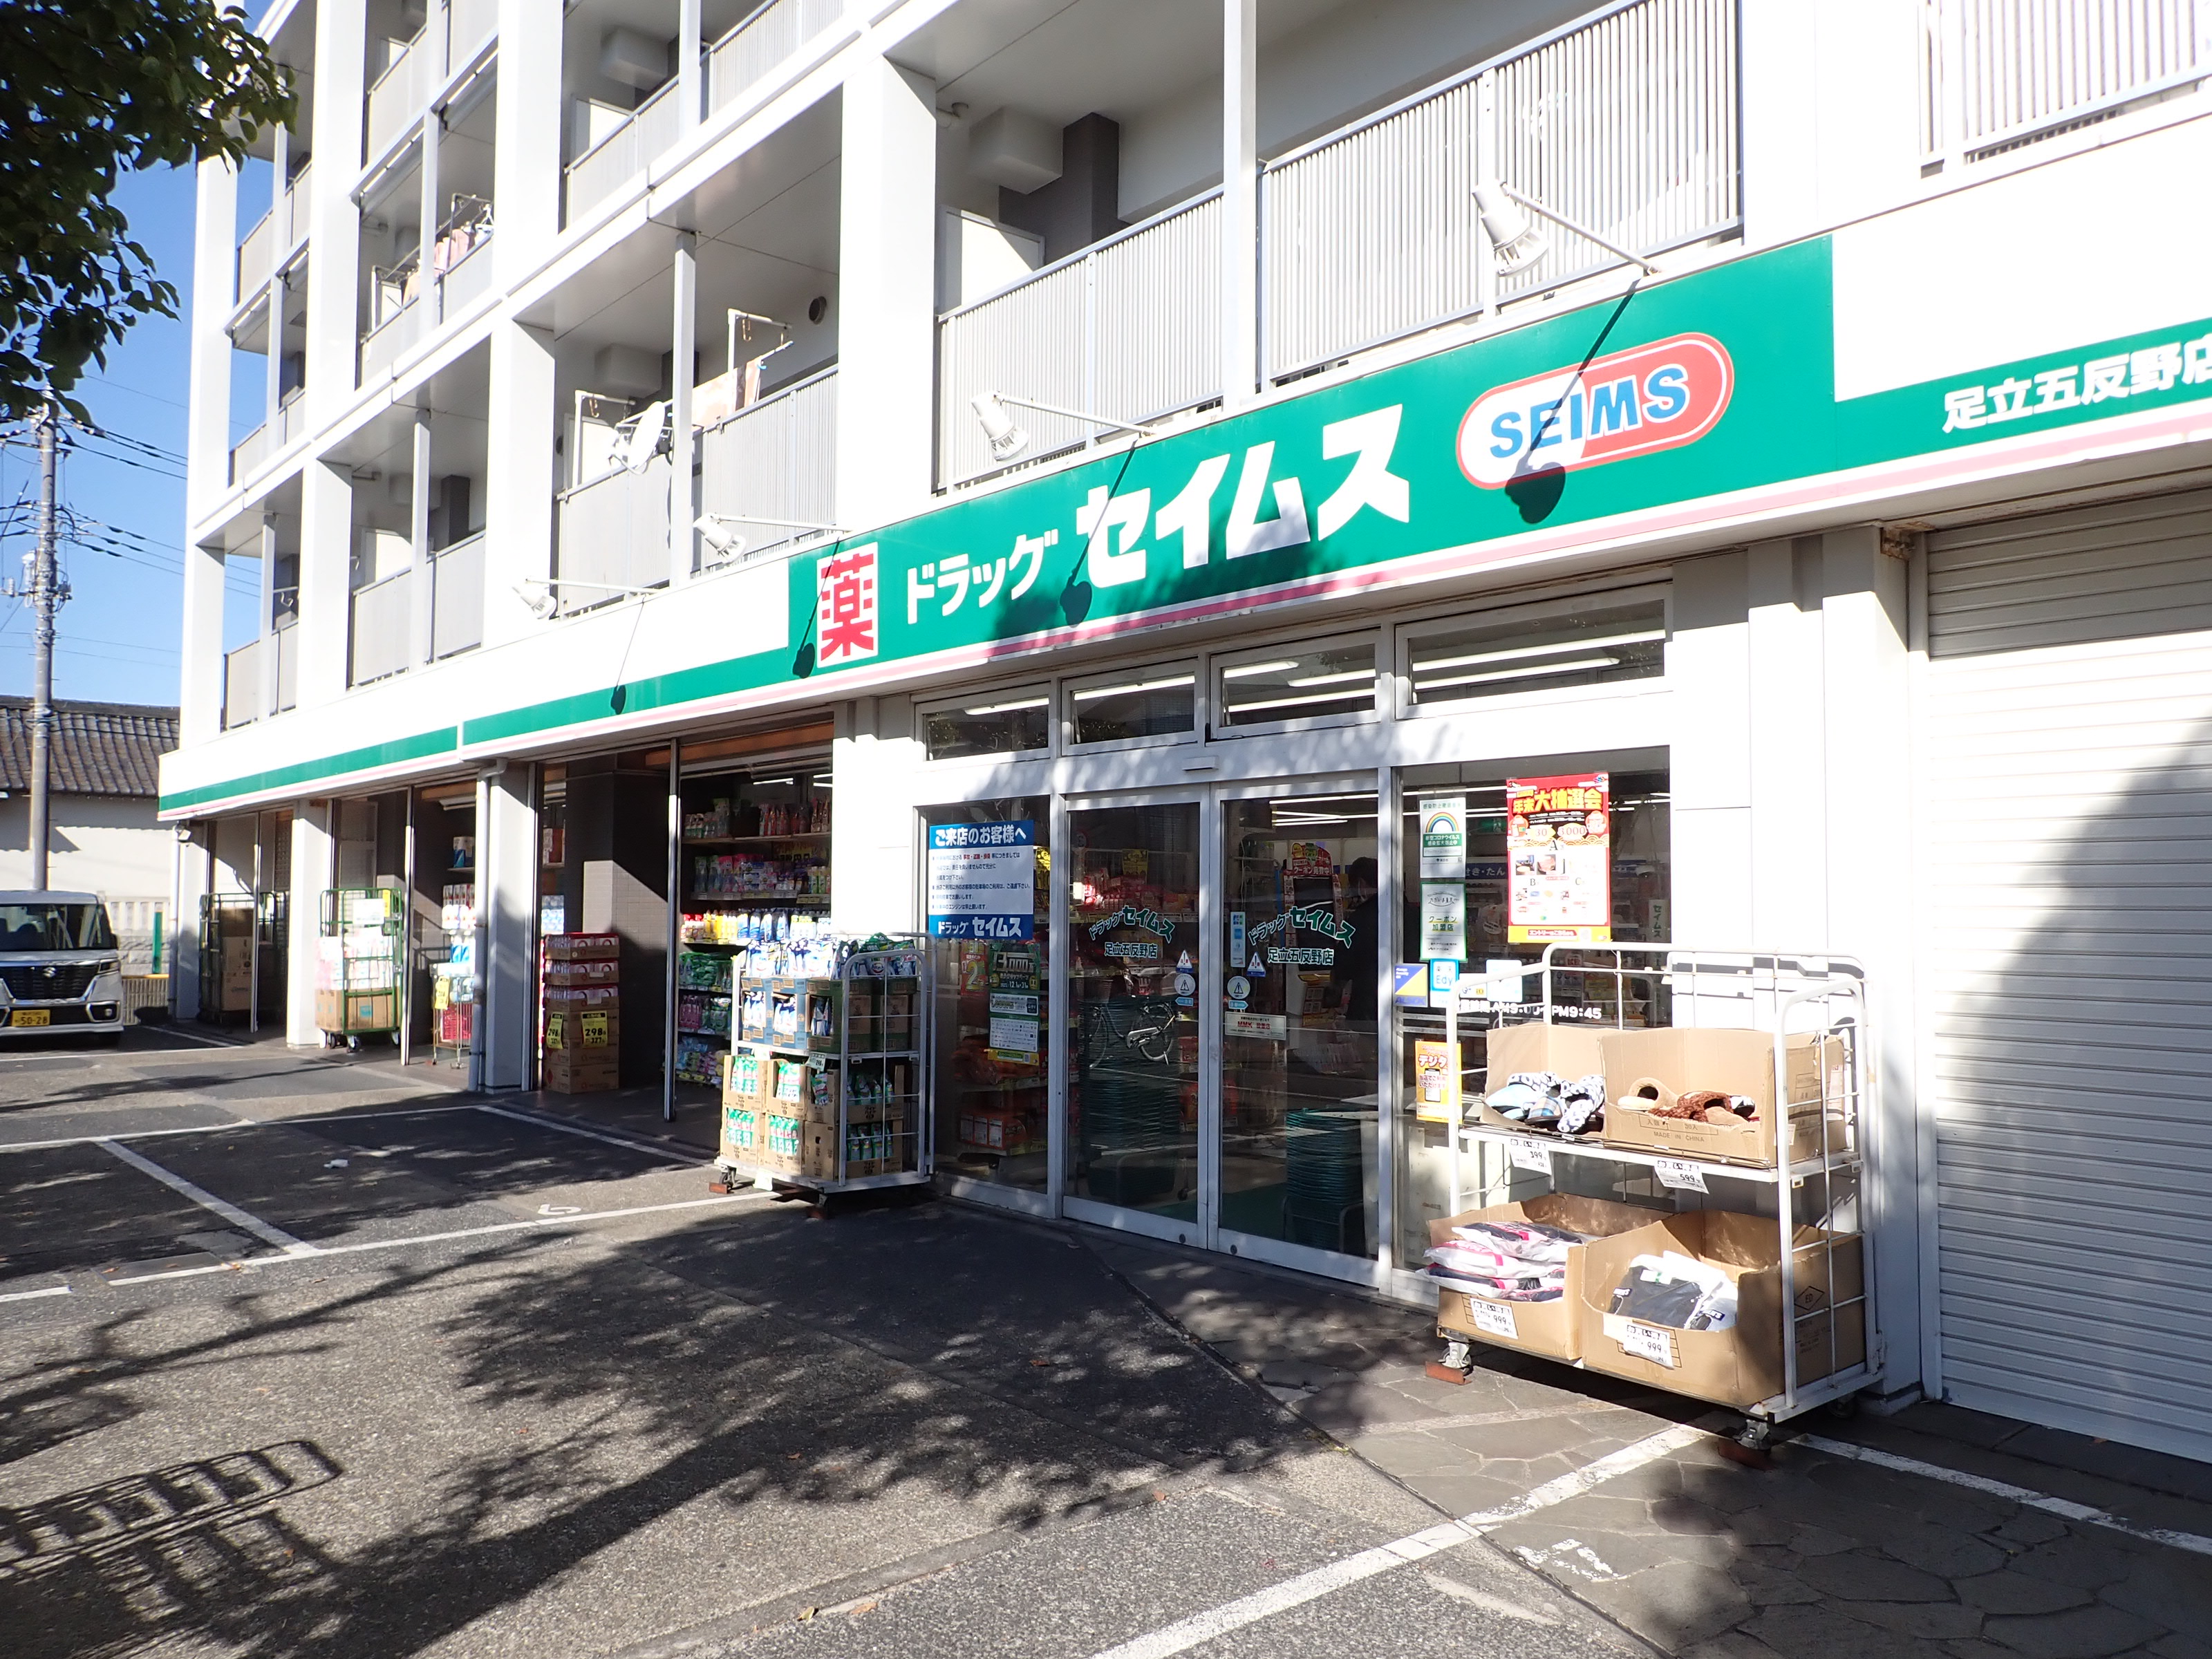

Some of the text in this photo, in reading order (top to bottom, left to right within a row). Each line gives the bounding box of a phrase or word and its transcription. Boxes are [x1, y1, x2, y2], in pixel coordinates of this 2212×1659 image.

[1942, 333, 2212, 433] 足立五反野店
[1489, 367, 1687, 459] SEIMS
[907, 404, 1409, 624] ドラッグ セイムス
[821, 553, 874, 661] 薬
[935, 825, 1027, 846] ご来店のお客様へ
[972, 916, 1022, 937] セイムス
[1104, 941, 1159, 959] 足立五反野店
[1267, 946, 1335, 966] 足立五反野店
[1436, 975, 1453, 986] Edy
[585, 1027, 603, 1036] 298
[1530, 1151, 1543, 1159] 399
[1680, 1173, 1696, 1183] 599
[1493, 1315, 1506, 1325] 999
[1647, 1341, 1662, 1353] 999
